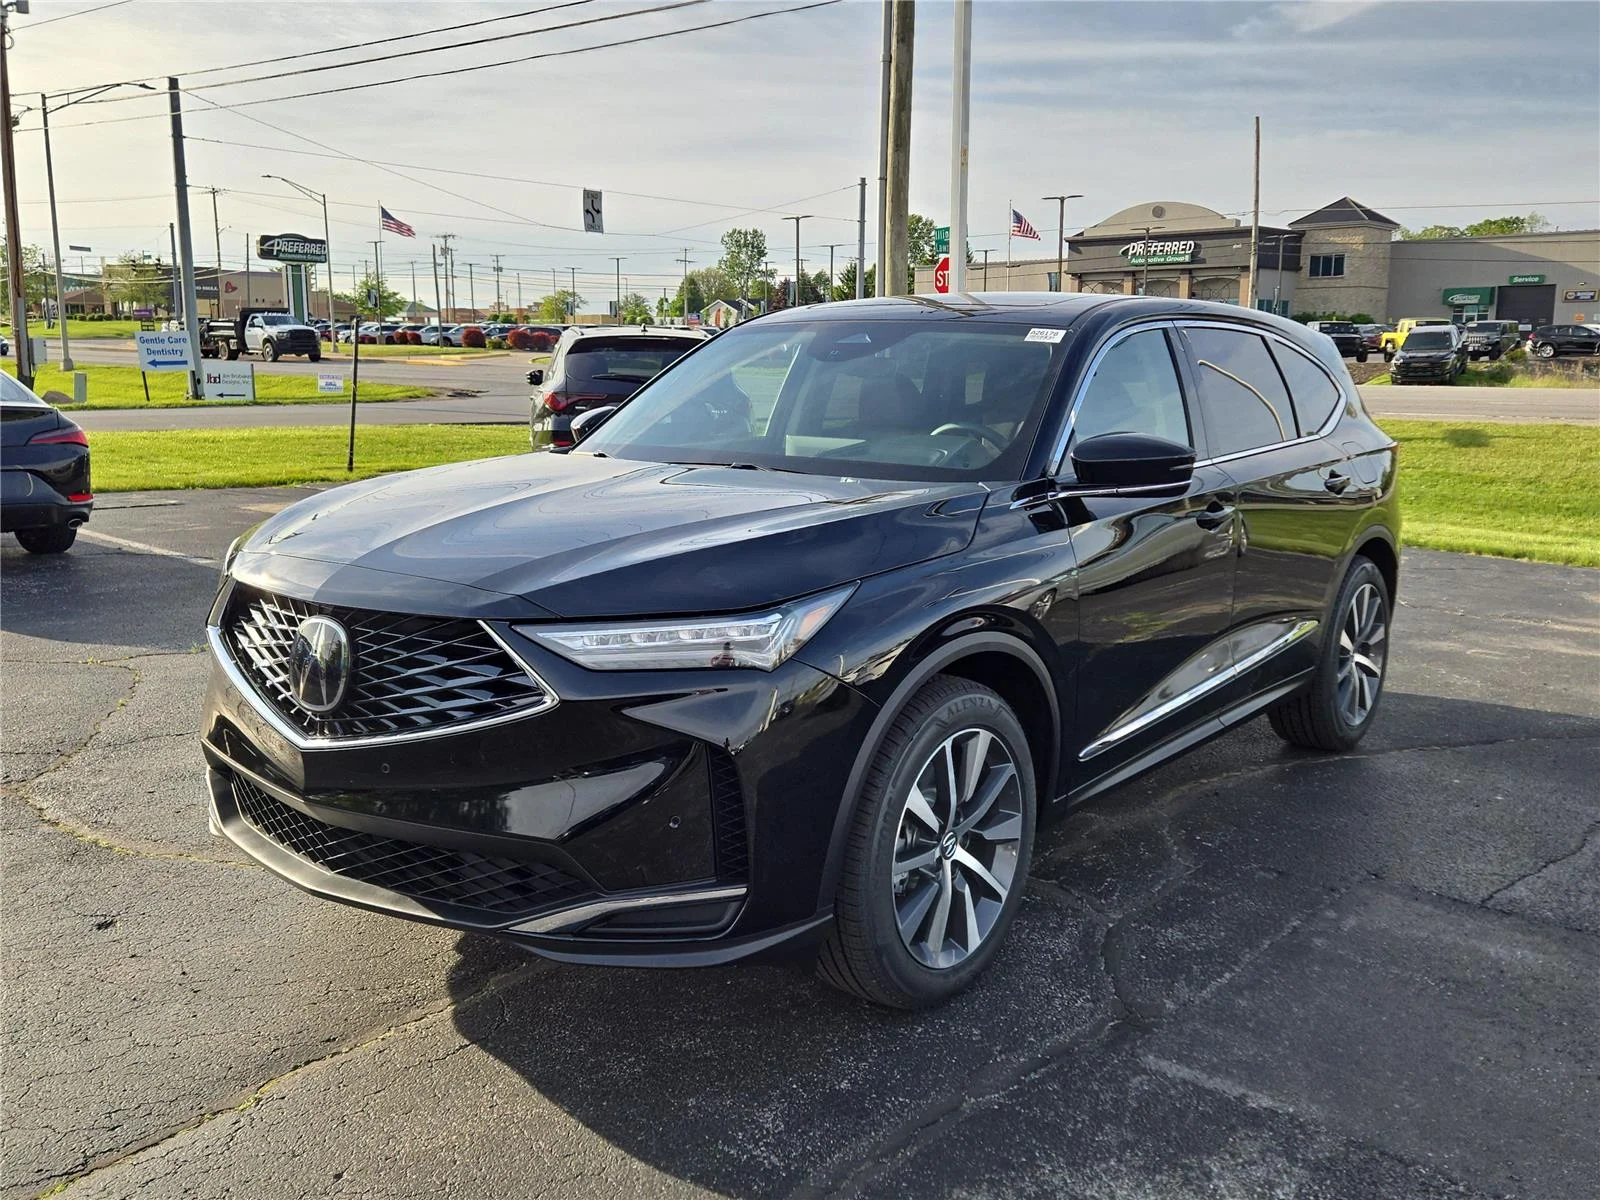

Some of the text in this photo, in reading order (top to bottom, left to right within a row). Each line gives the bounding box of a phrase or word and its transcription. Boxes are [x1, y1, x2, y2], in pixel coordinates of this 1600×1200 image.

[273, 238, 327, 255] PREFERRED
[1128, 240, 1195, 259] PREFERRED
[936, 270, 950, 287] ST
[139, 336, 187, 344] Gentle Care
[146, 347, 184, 357] Dentistry
[947, 697, 993, 717] ALENZA
